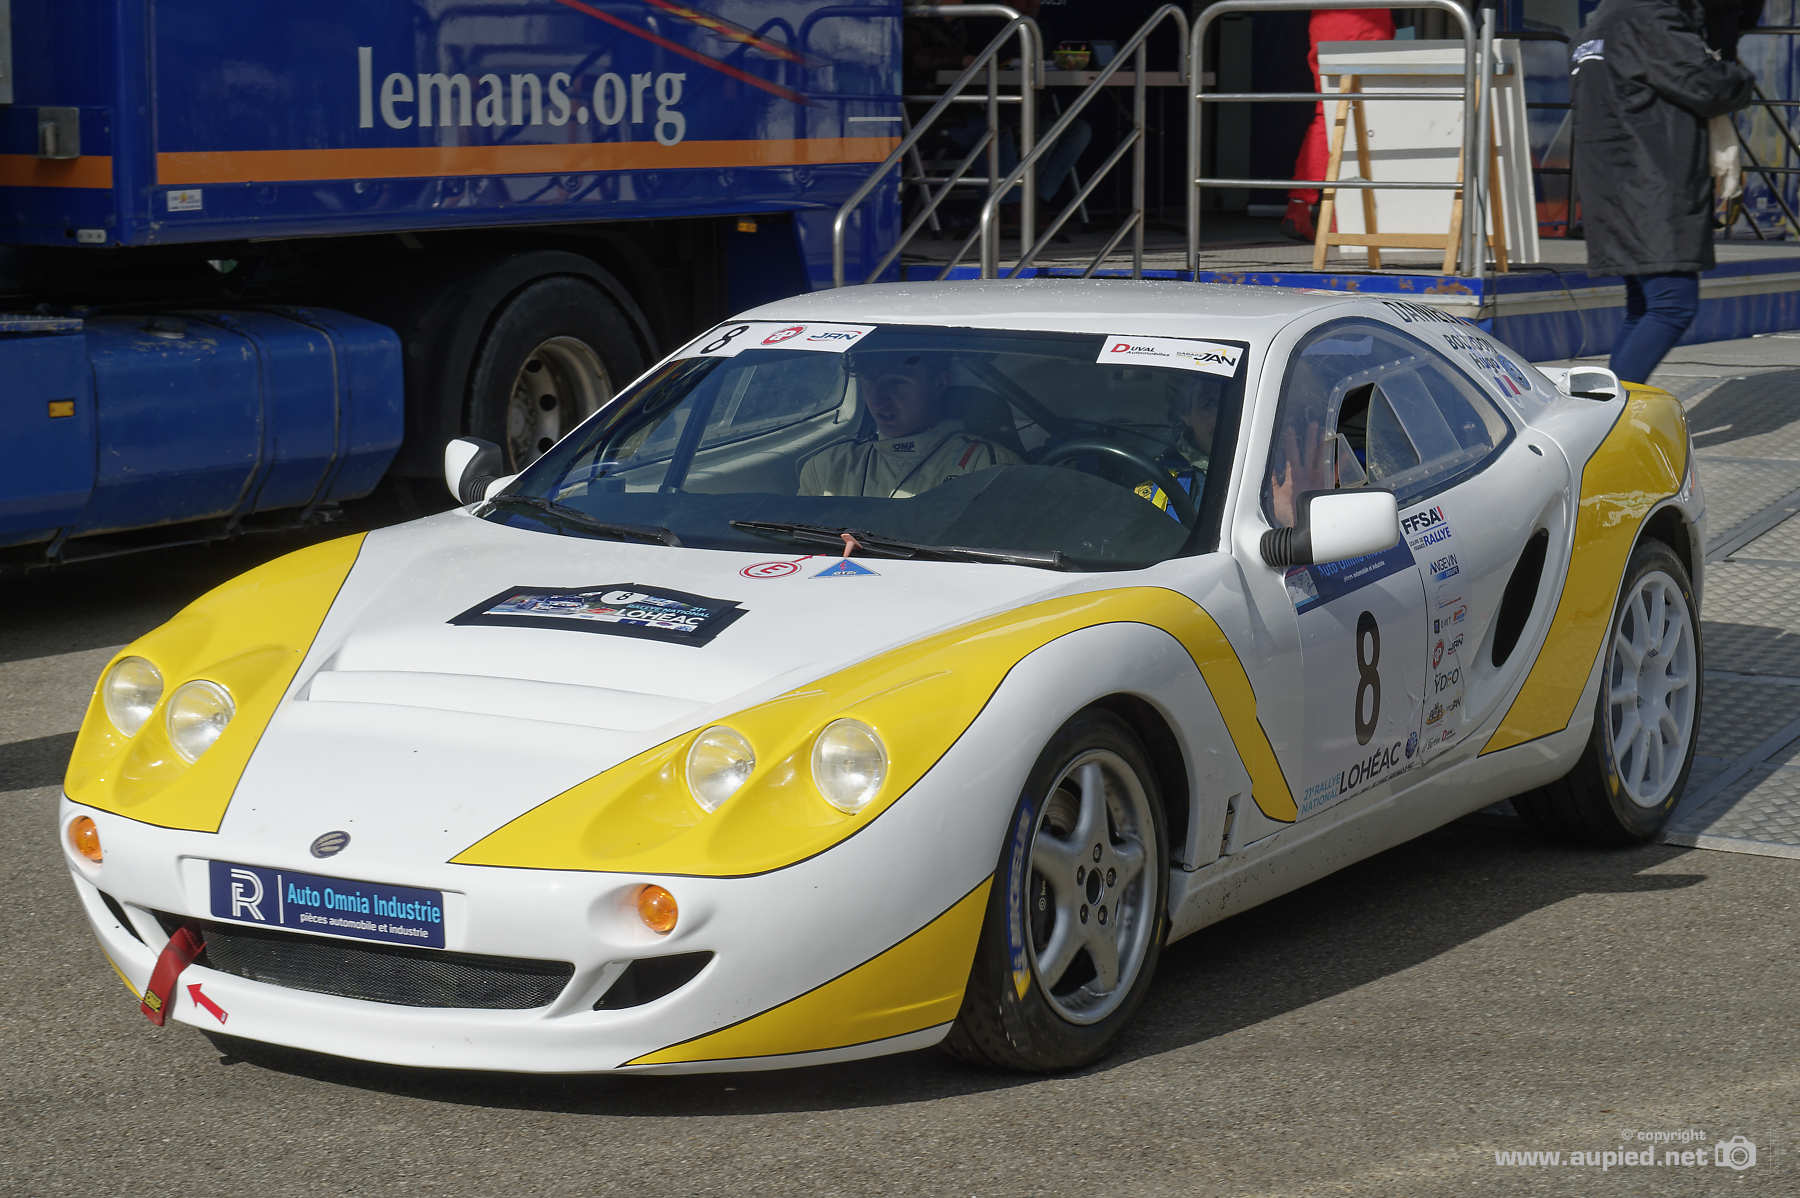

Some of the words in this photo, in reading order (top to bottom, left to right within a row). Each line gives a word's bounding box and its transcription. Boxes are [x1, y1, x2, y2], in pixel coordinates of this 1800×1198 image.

[358, 46, 686, 146] lemans.org
[700, 325, 750, 354] 8
[810, 332, 859, 341] JAN
[1194, 352, 1236, 366] JAN
[1468, 352, 1500, 374] Hugo
[1401, 508, 1441, 535] FFSA
[1424, 526, 1452, 547] RALLYE
[1430, 553, 1458, 575] ANGEVIN
[618, 592, 633, 601] 8
[614, 608, 705, 625] LOHÉAC
[661, 607, 711, 618] NATIONAL
[1355, 610, 1381, 746] 8
[1339, 741, 1401, 794] LOHÉAC
[1301, 789, 1339, 816] NATIONAL
[287, 883, 321, 907] Auto
[324, 888, 370, 915] Omnia
[374, 894, 441, 924] Industrie
[300, 912, 329, 926] pièces
[329, 916, 377, 931] automobile
[378, 923, 388, 933] et
[389, 923, 429, 938] industrie
